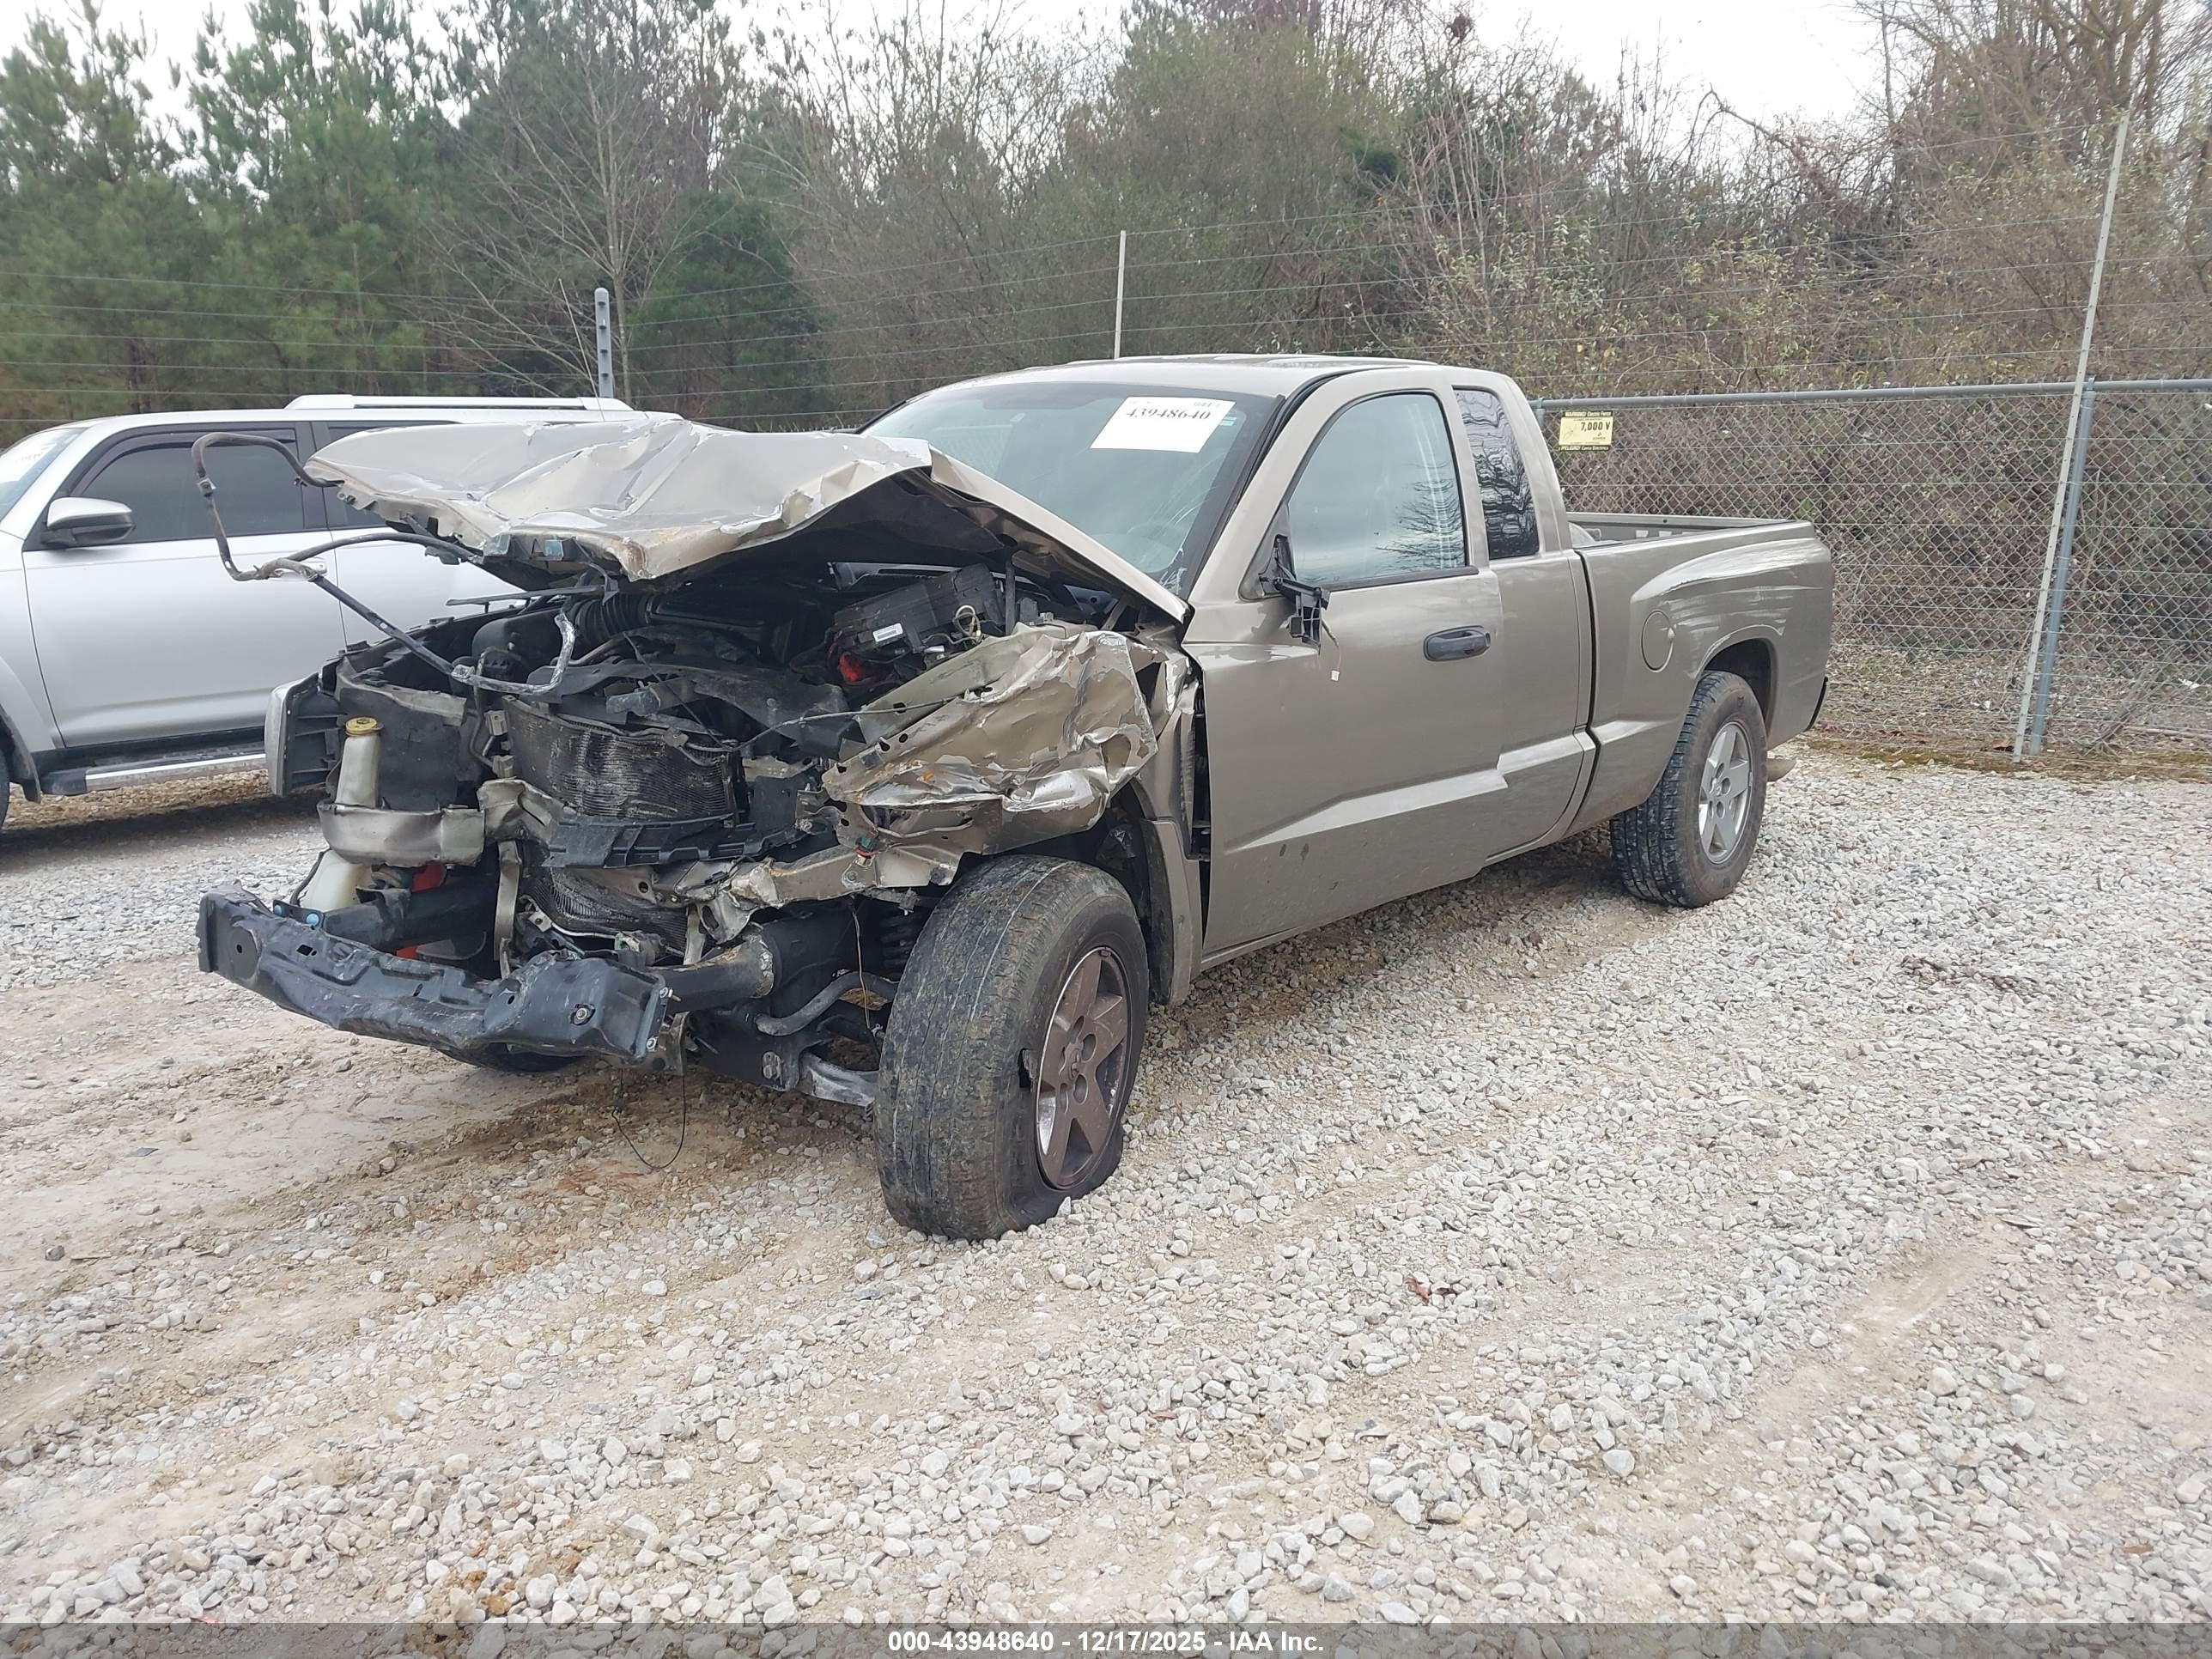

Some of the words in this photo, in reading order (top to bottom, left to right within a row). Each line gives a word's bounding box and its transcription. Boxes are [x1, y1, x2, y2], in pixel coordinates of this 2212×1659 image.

[1126, 407, 1212, 421] 43948640
[1580, 422, 1603, 432] 7,000
[1605, 421, 1611, 430] V
